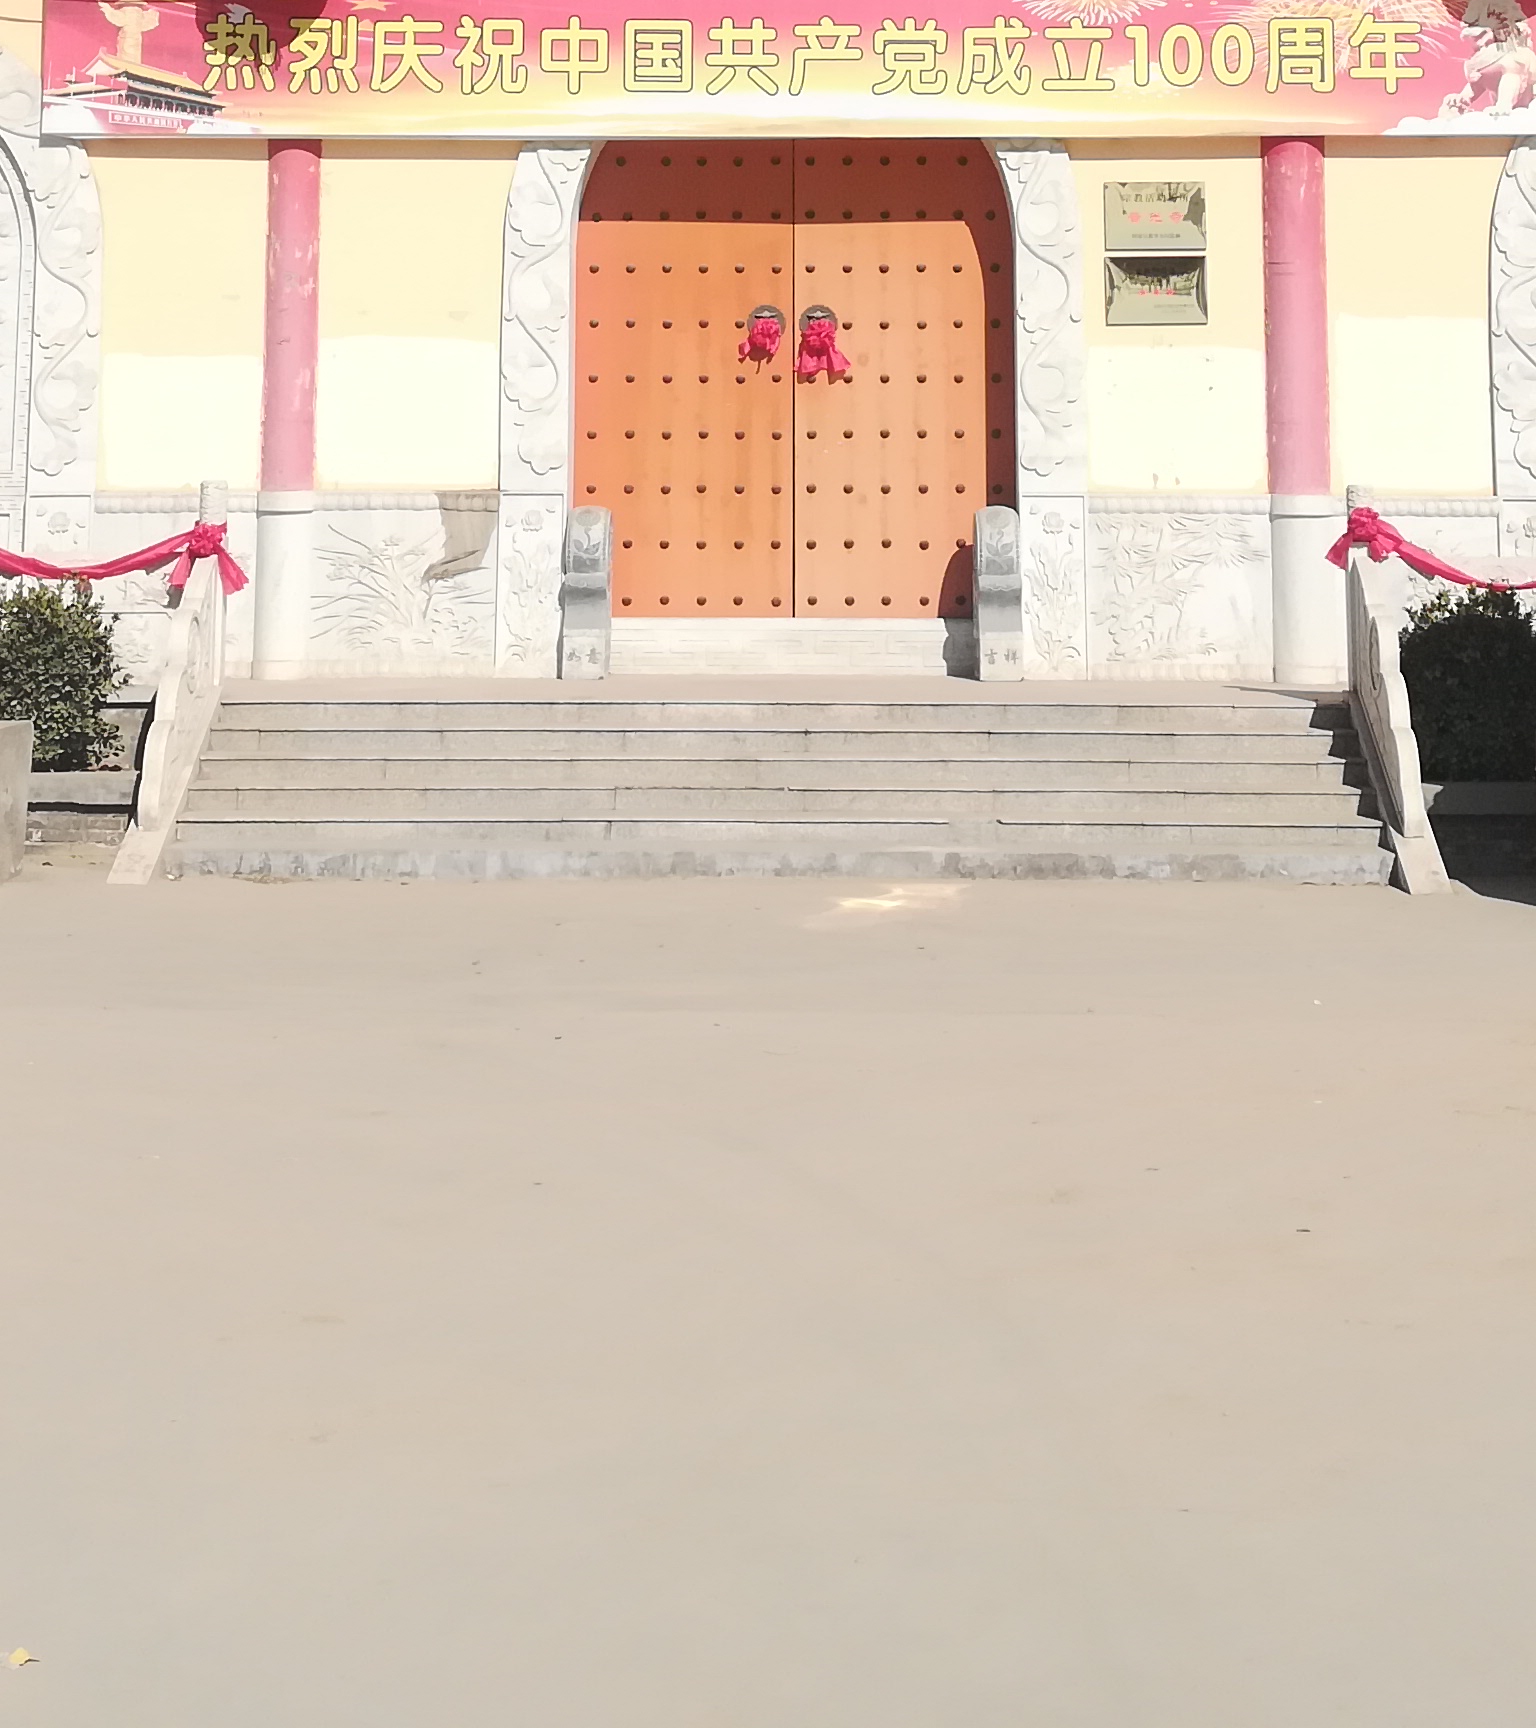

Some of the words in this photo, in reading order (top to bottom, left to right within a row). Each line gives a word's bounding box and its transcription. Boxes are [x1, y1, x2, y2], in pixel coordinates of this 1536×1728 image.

[202, 13, 1425, 96] 热烈庆祝中国共产党成立100周年
